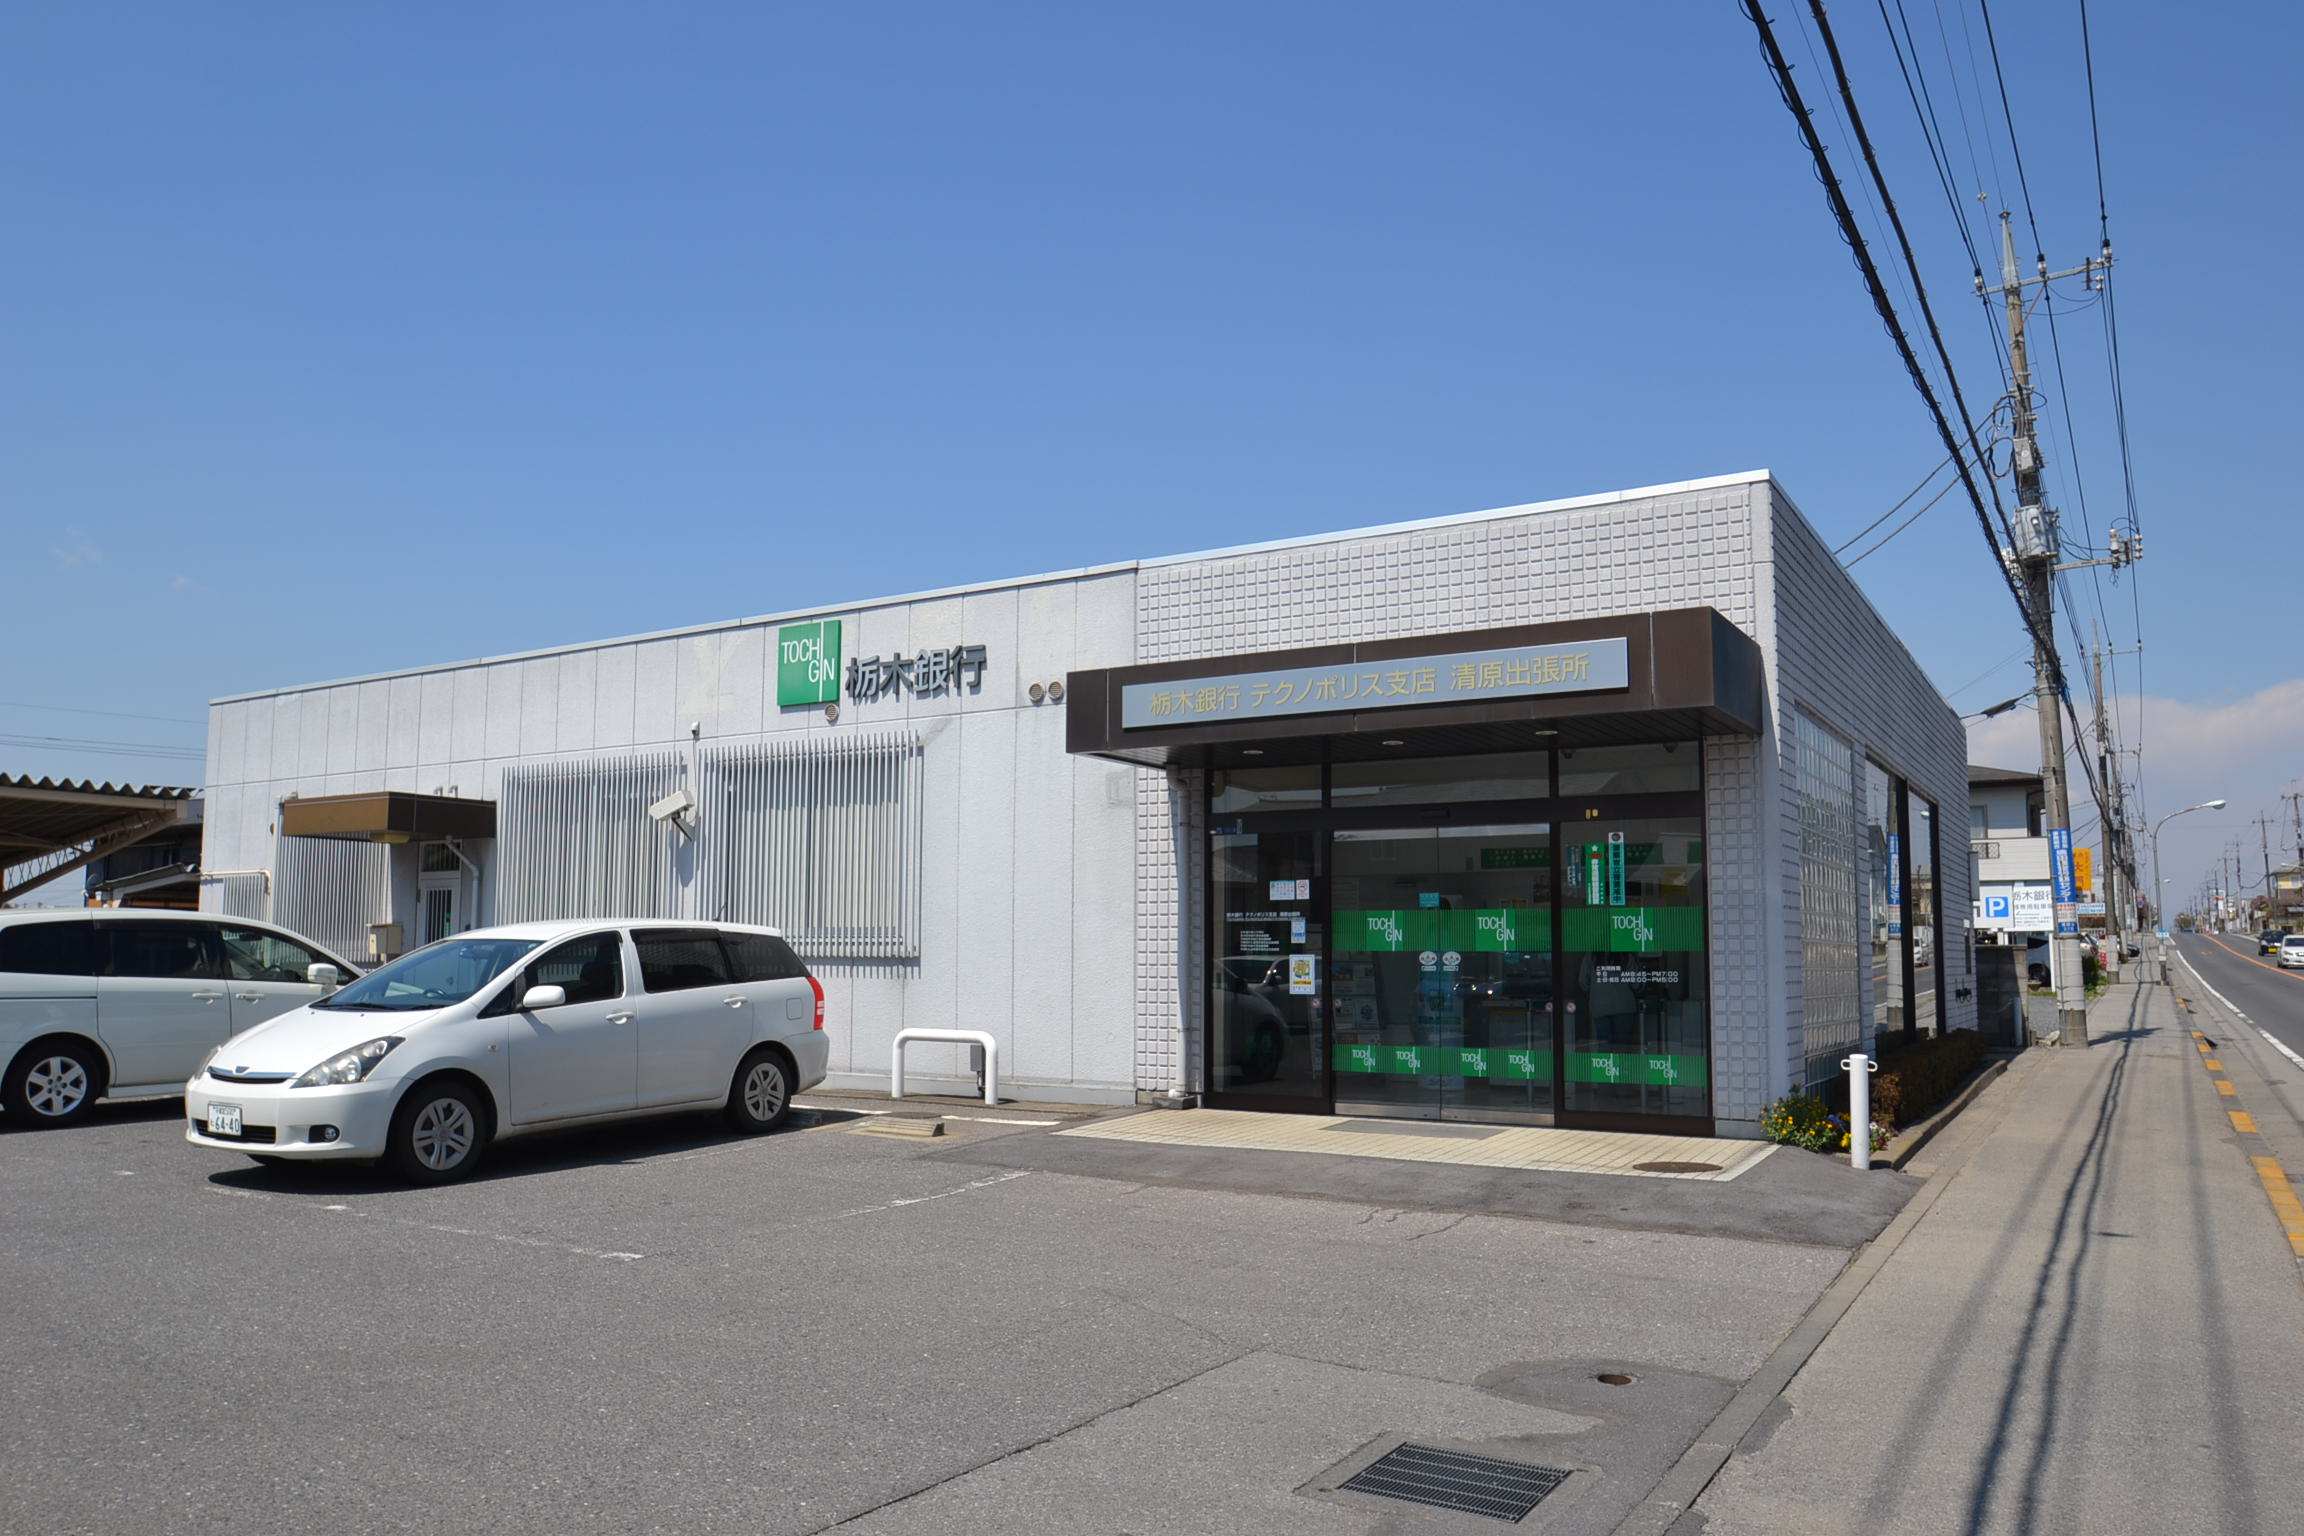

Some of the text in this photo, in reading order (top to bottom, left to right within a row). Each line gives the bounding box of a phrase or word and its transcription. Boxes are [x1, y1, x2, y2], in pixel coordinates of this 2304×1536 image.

[845, 644, 987, 698] 栃木銀行
[1151, 652, 1590, 719] 栃木銀行 テクノポリス支店 清原出張所
[1988, 898, 2005, 917] P
